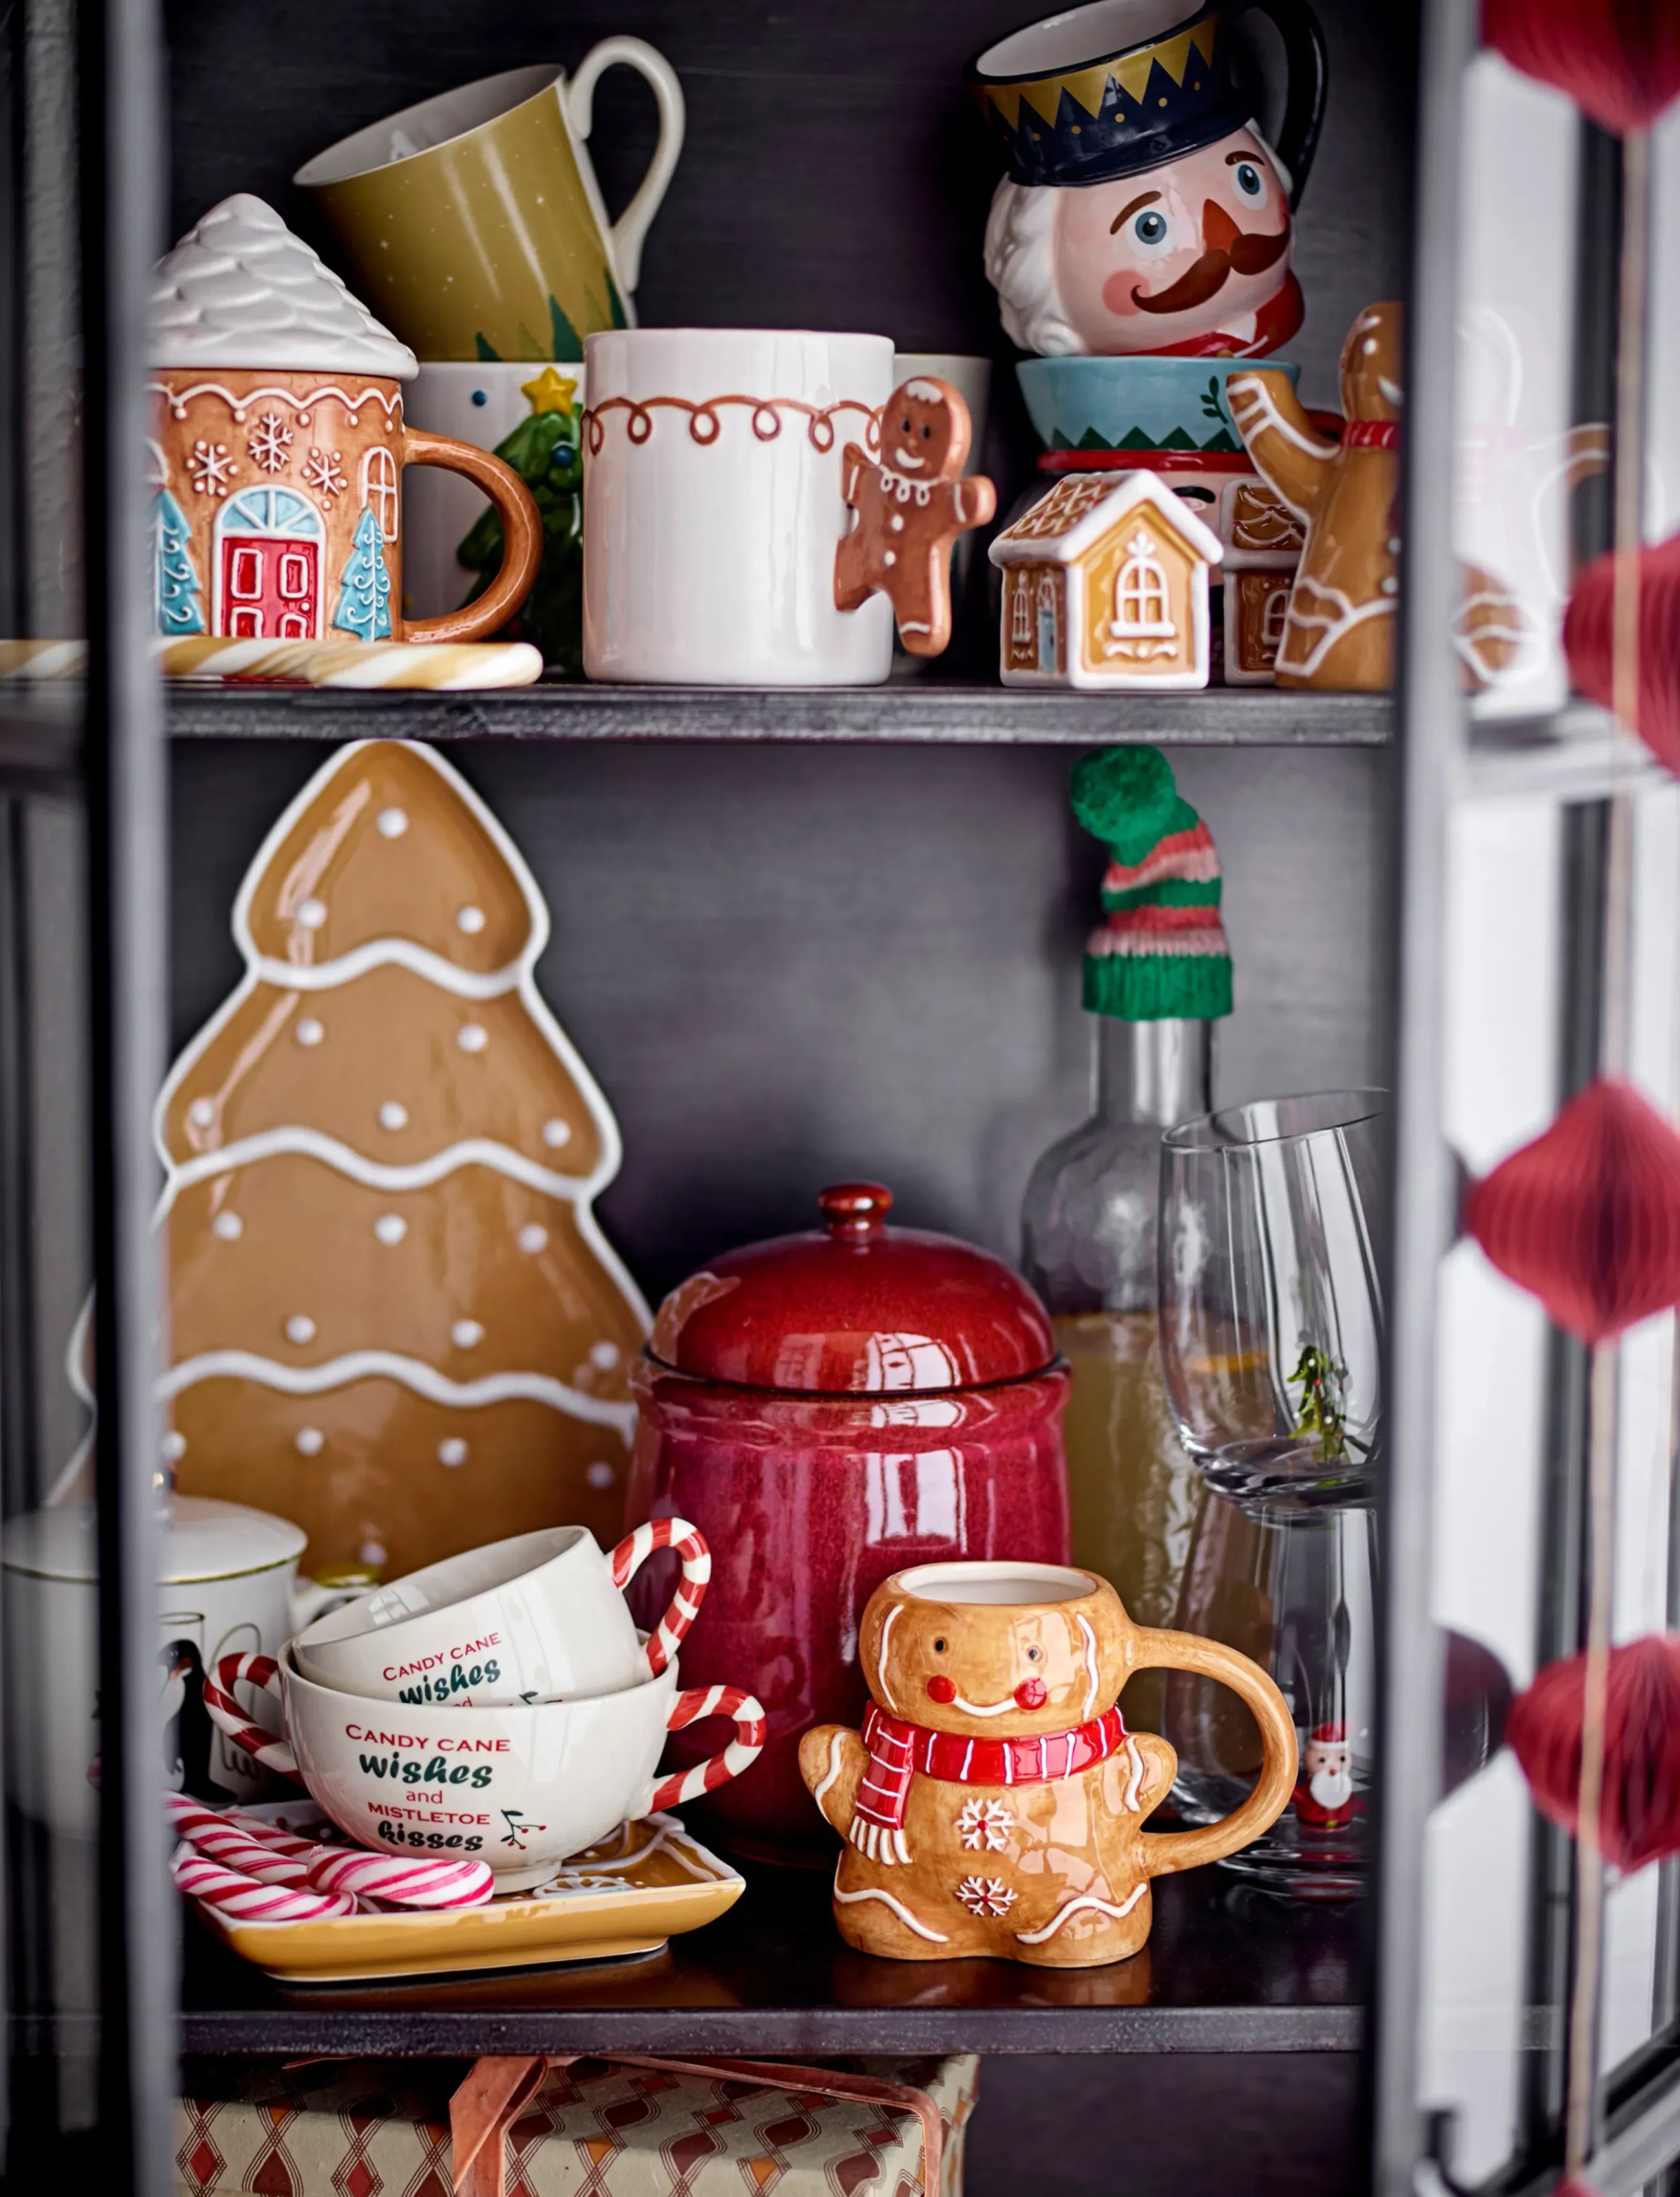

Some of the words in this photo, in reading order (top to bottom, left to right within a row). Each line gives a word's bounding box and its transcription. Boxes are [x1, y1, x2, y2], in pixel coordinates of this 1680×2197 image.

[383, 1652, 445, 1681] CANDY
[450, 1632, 501, 1659] CANE
[399, 1659, 501, 1705] wishes
[345, 1724, 430, 1749] CANDY
[437, 1739, 511, 1752] CANE
[359, 1751, 493, 1788] wishes
[406, 1790, 443, 1804] and
[368, 1802, 490, 1825] MISTLETOE
[377, 1820, 483, 1851] kisses
